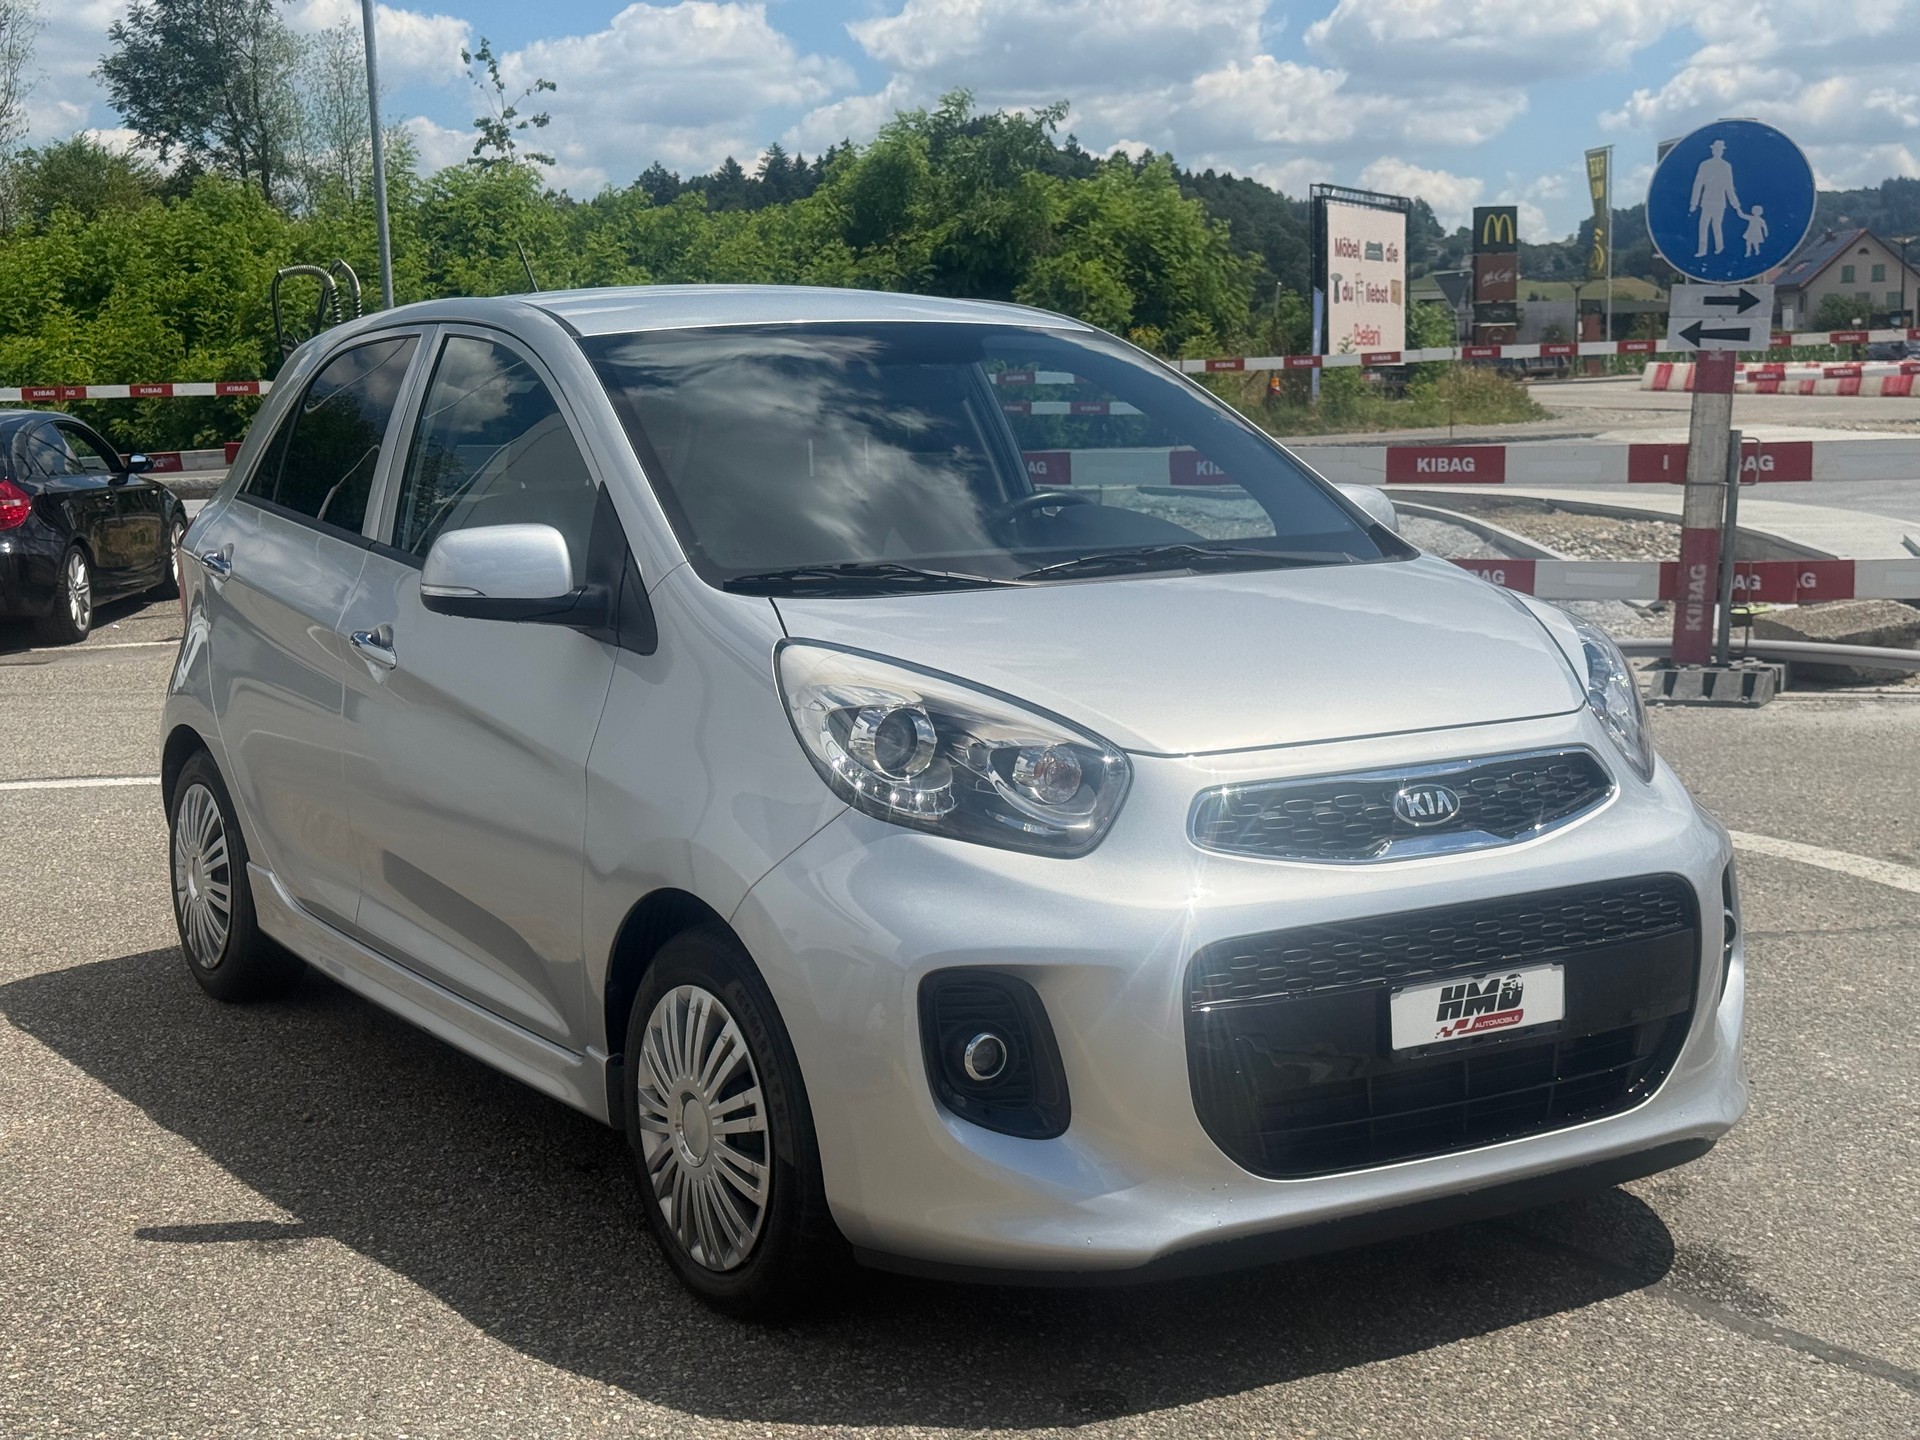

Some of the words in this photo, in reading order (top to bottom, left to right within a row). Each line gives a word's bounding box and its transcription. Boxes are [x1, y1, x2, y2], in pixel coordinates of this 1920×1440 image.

[1385, 242, 1398, 262] die
[1342, 281, 1353, 302] du
[1365, 282, 1389, 304] liebst
[33, 389, 56, 397] KIBAG
[1416, 457, 1475, 473] KIBAG
[1685, 564, 1707, 632] KIBAG
[1403, 790, 1454, 818] KIA
[1474, 1015, 1520, 1029] AUTOMOBILE
